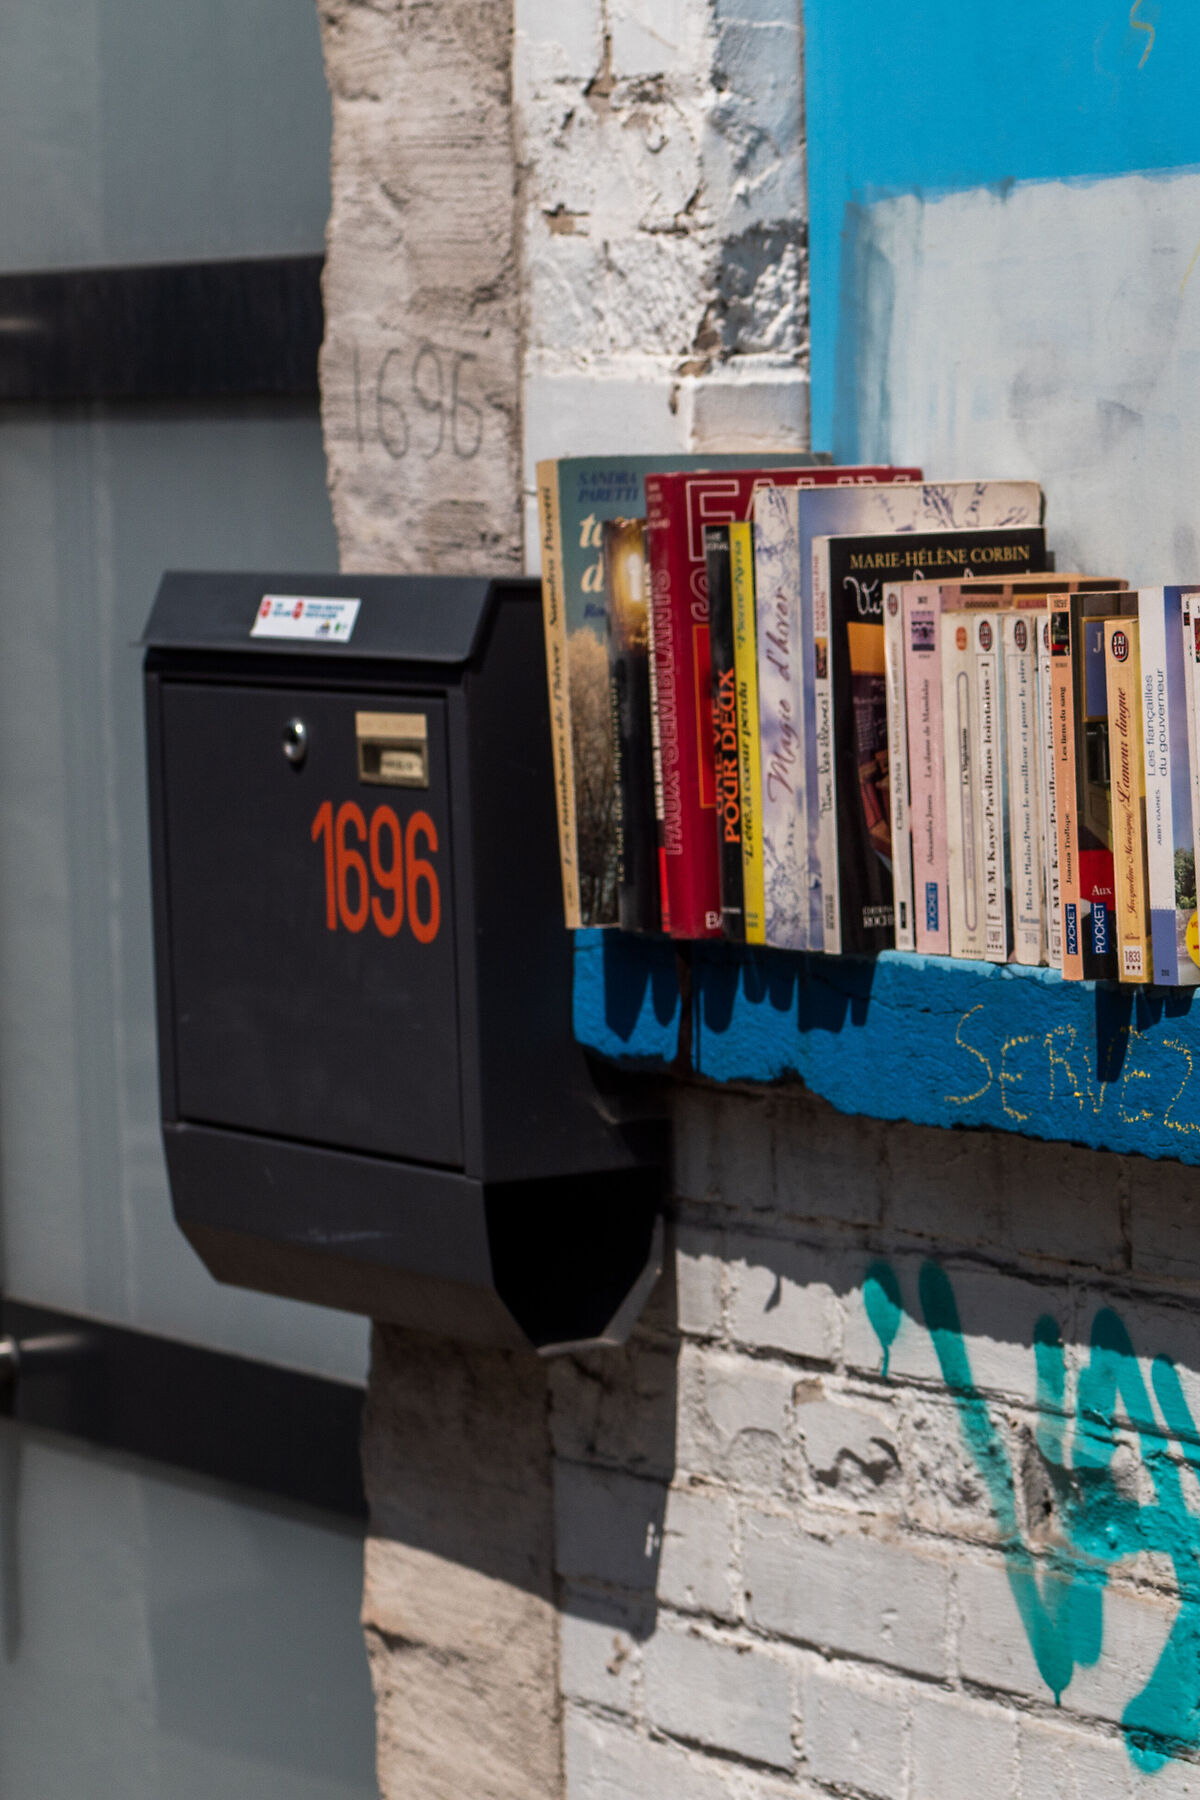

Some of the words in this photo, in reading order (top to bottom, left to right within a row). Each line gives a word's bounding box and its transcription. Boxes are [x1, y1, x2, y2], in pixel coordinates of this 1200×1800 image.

[353, 342, 483, 461] 1696
[849, 546, 969, 570] MARIE-HÉLÈNE
[969, 544, 1030, 565] CORBIN
[1017, 659, 1027, 684] pire
[717, 667, 737, 751] DEUX
[980, 679, 991, 744] lointains
[1058, 686, 1067, 708] sang
[1114, 688, 1130, 737] dingue
[1157, 668, 1169, 754] gouverneur
[1059, 709, 1067, 721] du
[1144, 673, 1158, 755] fiançailles
[1060, 723, 1068, 744] liens
[1060, 745, 1068, 762] Les
[1145, 757, 1157, 777] Les
[1158, 757, 1168, 777] du
[893, 762, 904, 794] Sylvia
[721, 758, 741, 843] POUR
[895, 797, 903, 831] Claire
[924, 793, 934, 817] Jones
[925, 819, 934, 865] Alexandra
[1062, 813, 1072, 849] Trollope
[1154, 825, 1162, 845] ABBY
[311, 799, 441, 945] 1696
[986, 866, 996, 883] M.
[1064, 852, 1073, 885] Joanna
[926, 882, 938, 929] POCKET
[987, 888, 997, 906] M.
[1091, 884, 1112, 897] Aux
[1124, 866, 1139, 919] Jacqueline
[1066, 904, 1078, 954] POCKET
[1094, 903, 1106, 954] POCKET
[1124, 949, 1141, 963] 1833
